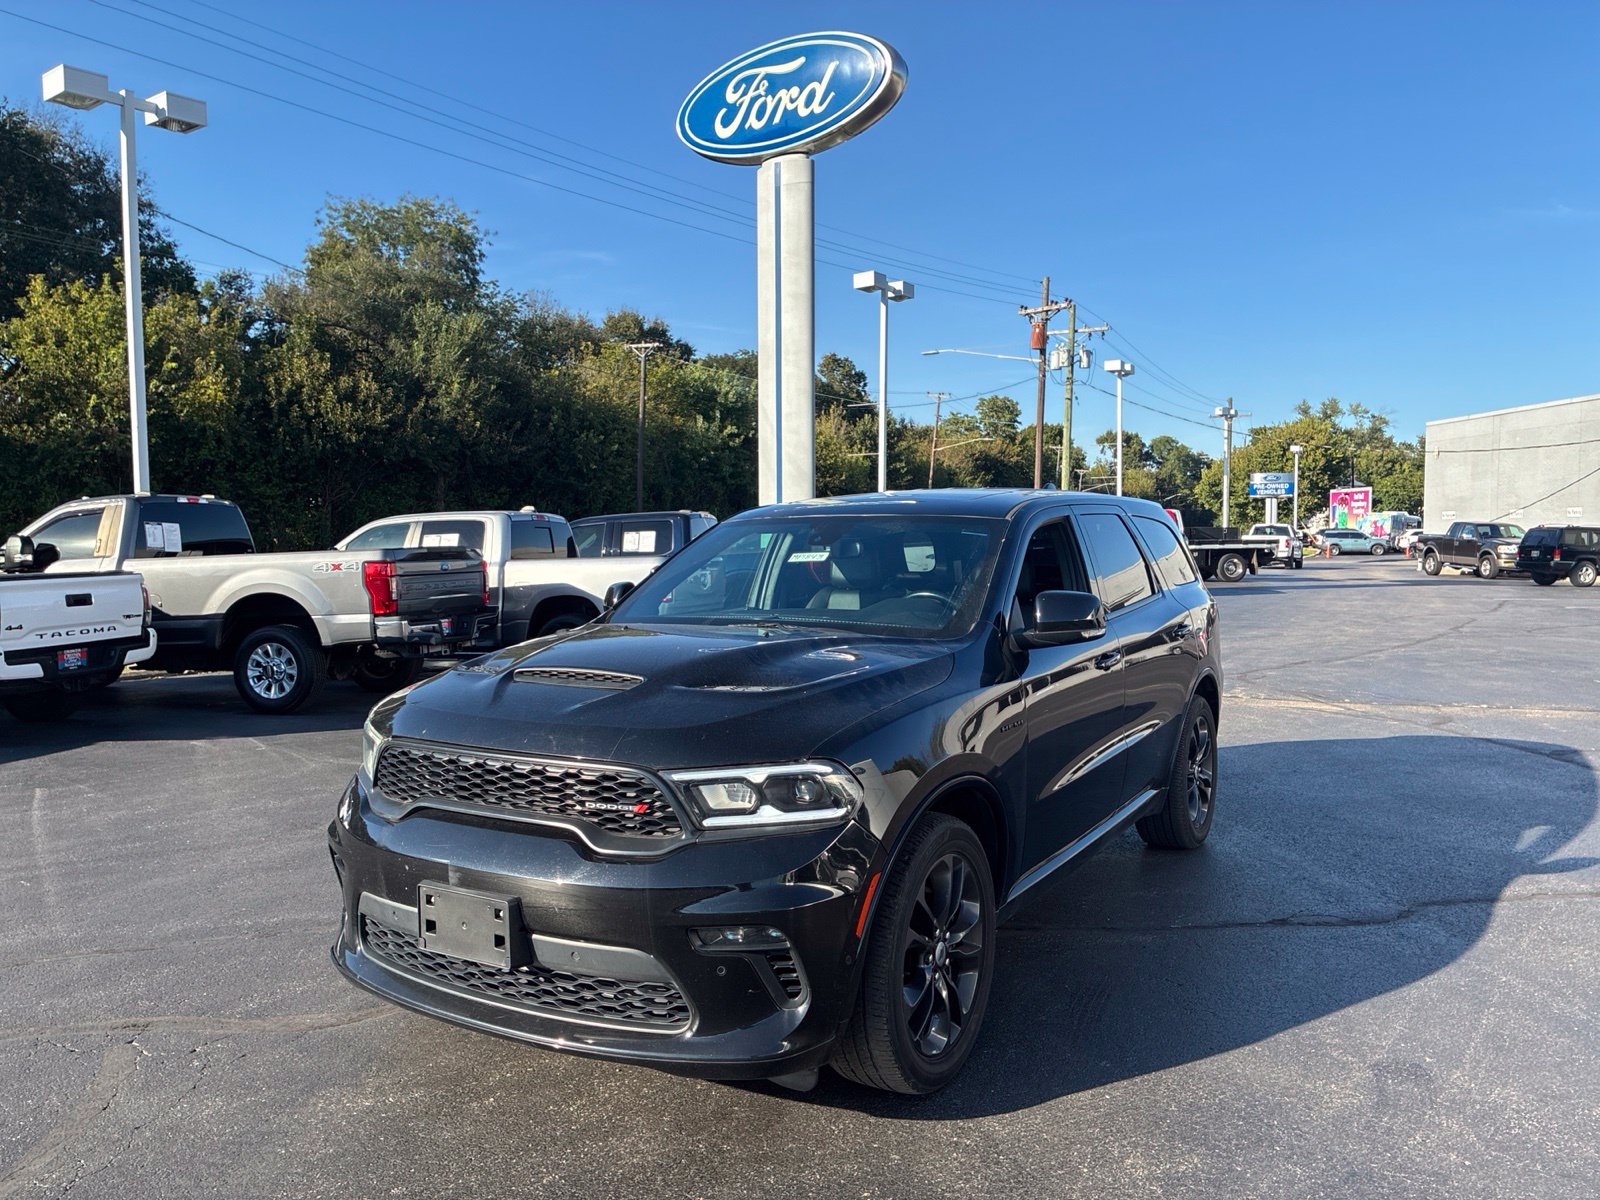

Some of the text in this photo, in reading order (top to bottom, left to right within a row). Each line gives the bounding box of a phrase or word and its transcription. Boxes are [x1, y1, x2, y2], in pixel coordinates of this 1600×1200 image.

[714, 56, 839, 139] Ford
[312, 561, 360, 573] 4x4
[35, 625, 117, 639] TACOMA
[586, 802, 635, 811] DODGE
